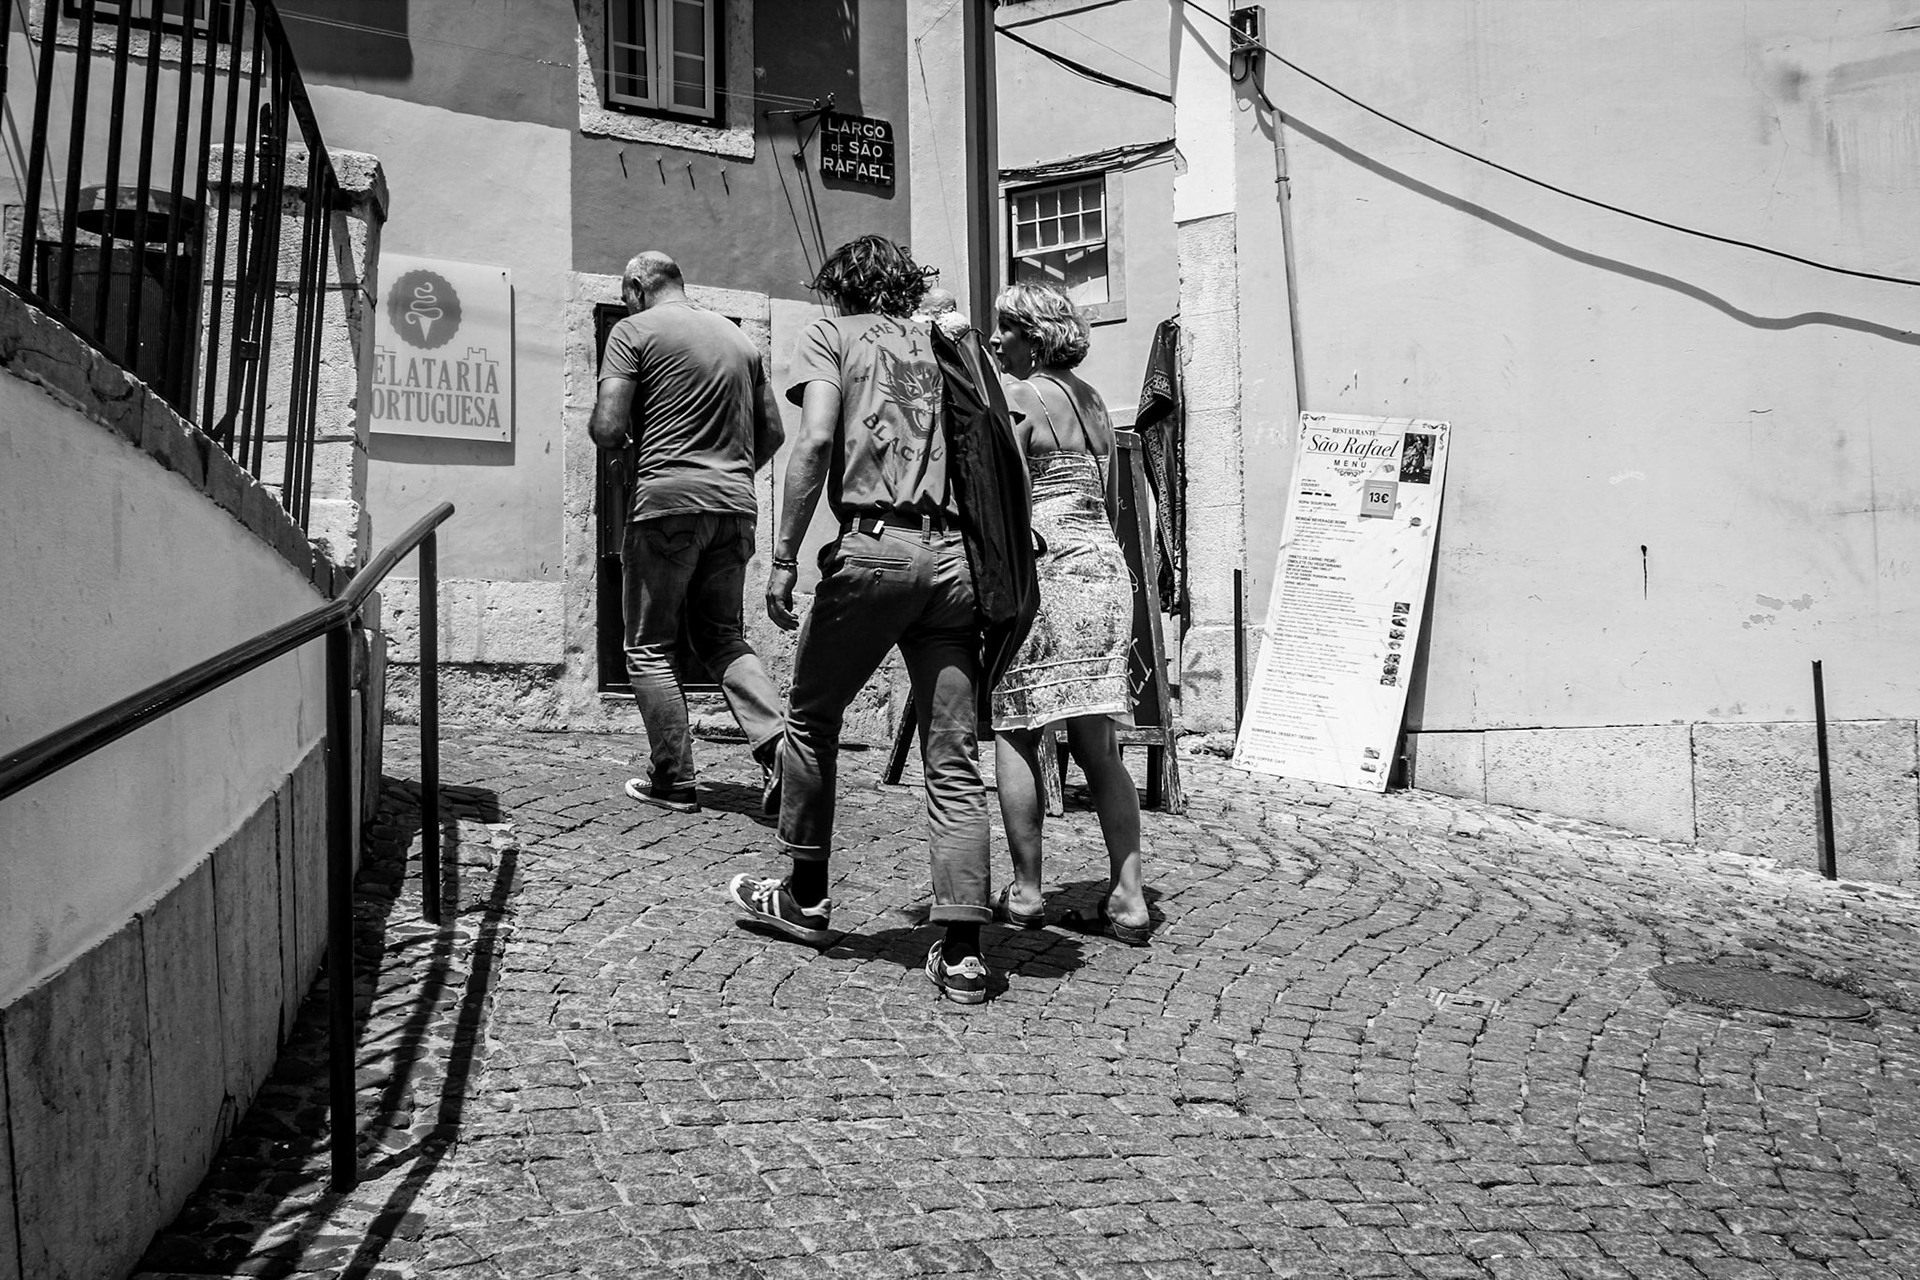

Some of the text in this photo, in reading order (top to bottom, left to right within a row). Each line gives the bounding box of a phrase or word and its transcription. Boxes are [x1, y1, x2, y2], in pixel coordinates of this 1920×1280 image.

[828, 117, 886, 139] LARGO
[831, 140, 883, 158] DE SÃO
[823, 156, 891, 179] RAFAEL
[860, 323, 894, 344] THE
[372, 353, 500, 394] ELATARIA
[854, 374, 870, 384] EST
[371, 387, 501, 429] ORTUGUESA
[1332, 427, 1378, 437] RESTAURANTE
[1307, 433, 1400, 461] São Rafael
[1334, 459, 1367, 468] MENU
[1368, 492, 1389, 504] 13€
